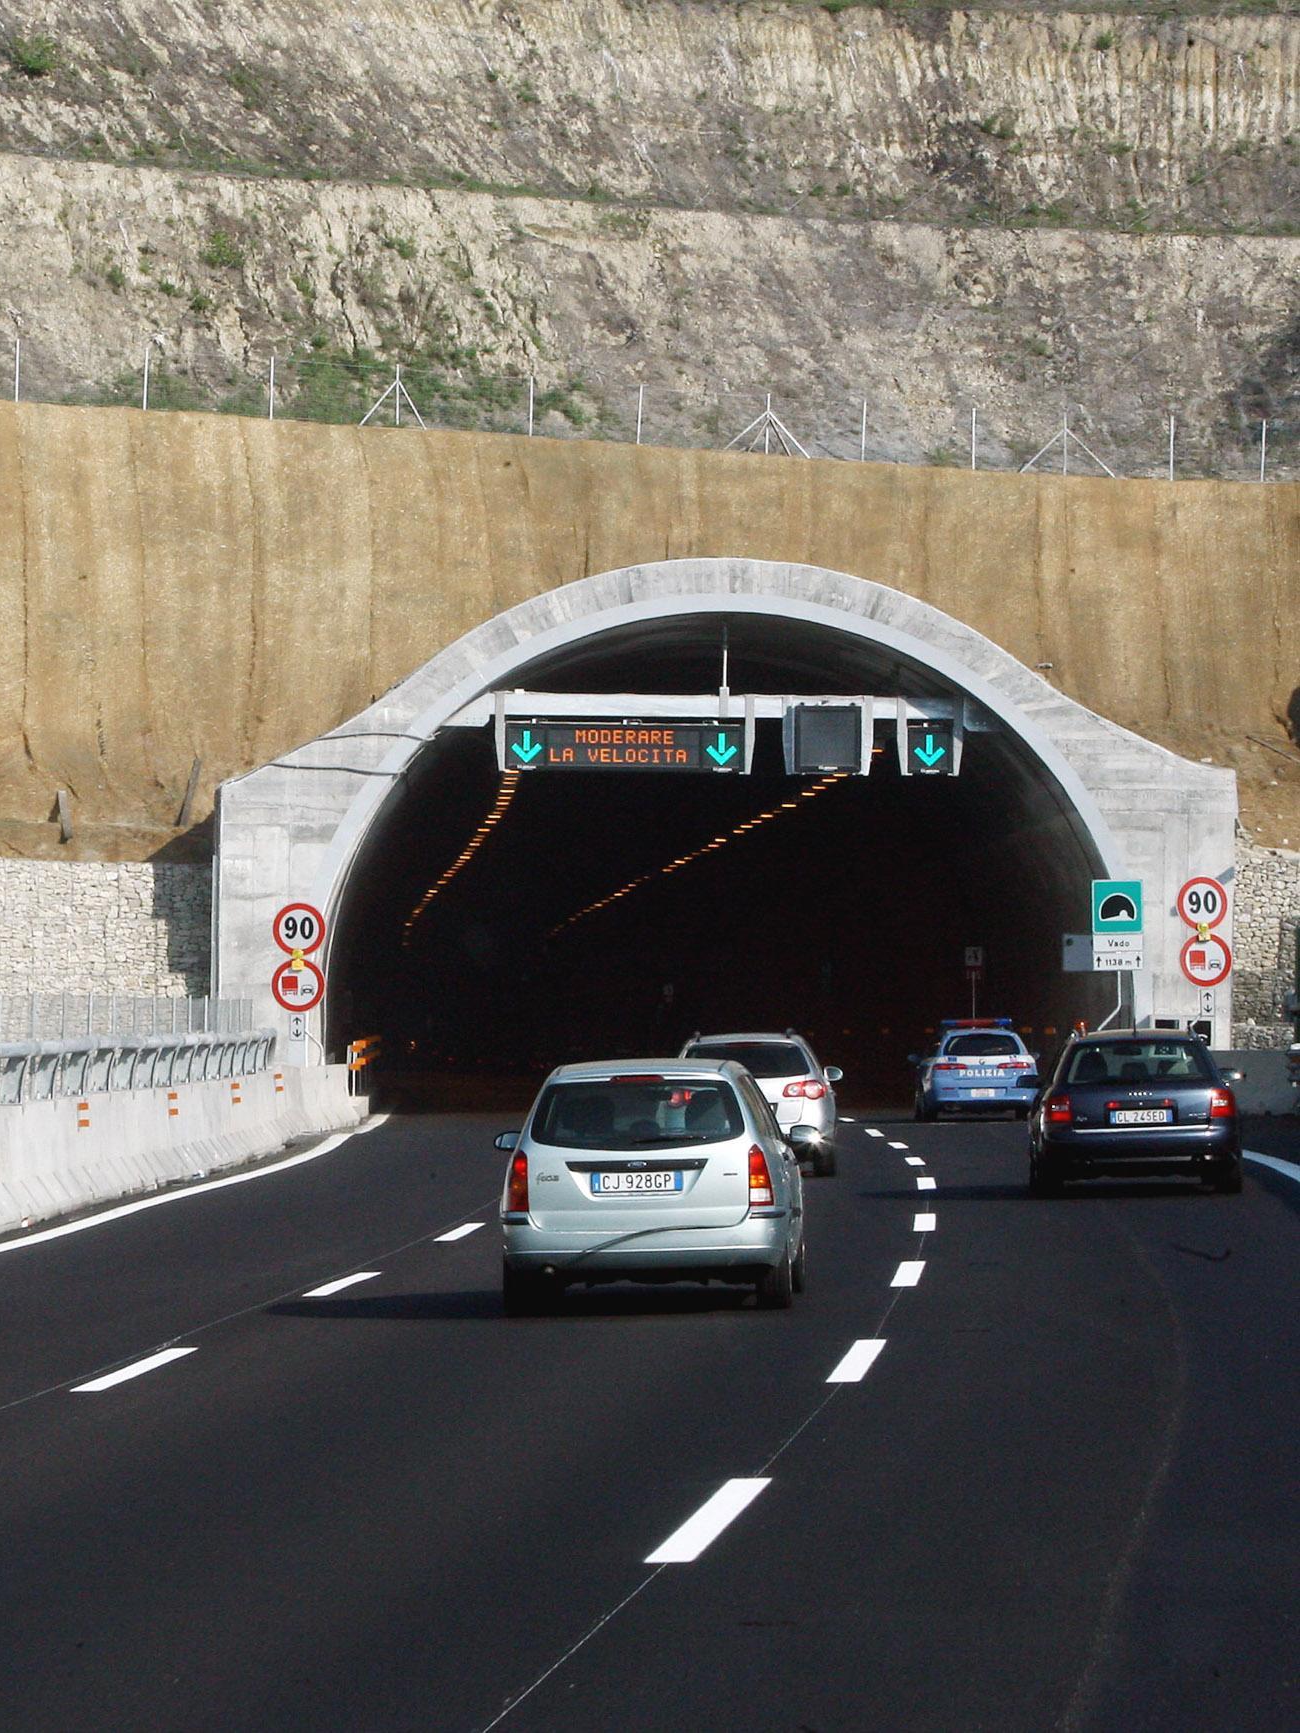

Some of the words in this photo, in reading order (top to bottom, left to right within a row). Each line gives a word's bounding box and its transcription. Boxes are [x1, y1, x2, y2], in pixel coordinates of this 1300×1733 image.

[575, 729, 675, 745] MODERARE
[550, 747, 574, 762] LA
[588, 748, 687, 763] VELOCITA
[1188, 890, 1217, 914] 90
[284, 916, 314, 940] 90
[1107, 939, 1130, 947] Vado
[959, 1069, 1005, 1077] POLIZIA
[602, 1175, 620, 1190] CJ
[625, 1173, 672, 1189] 928GP
